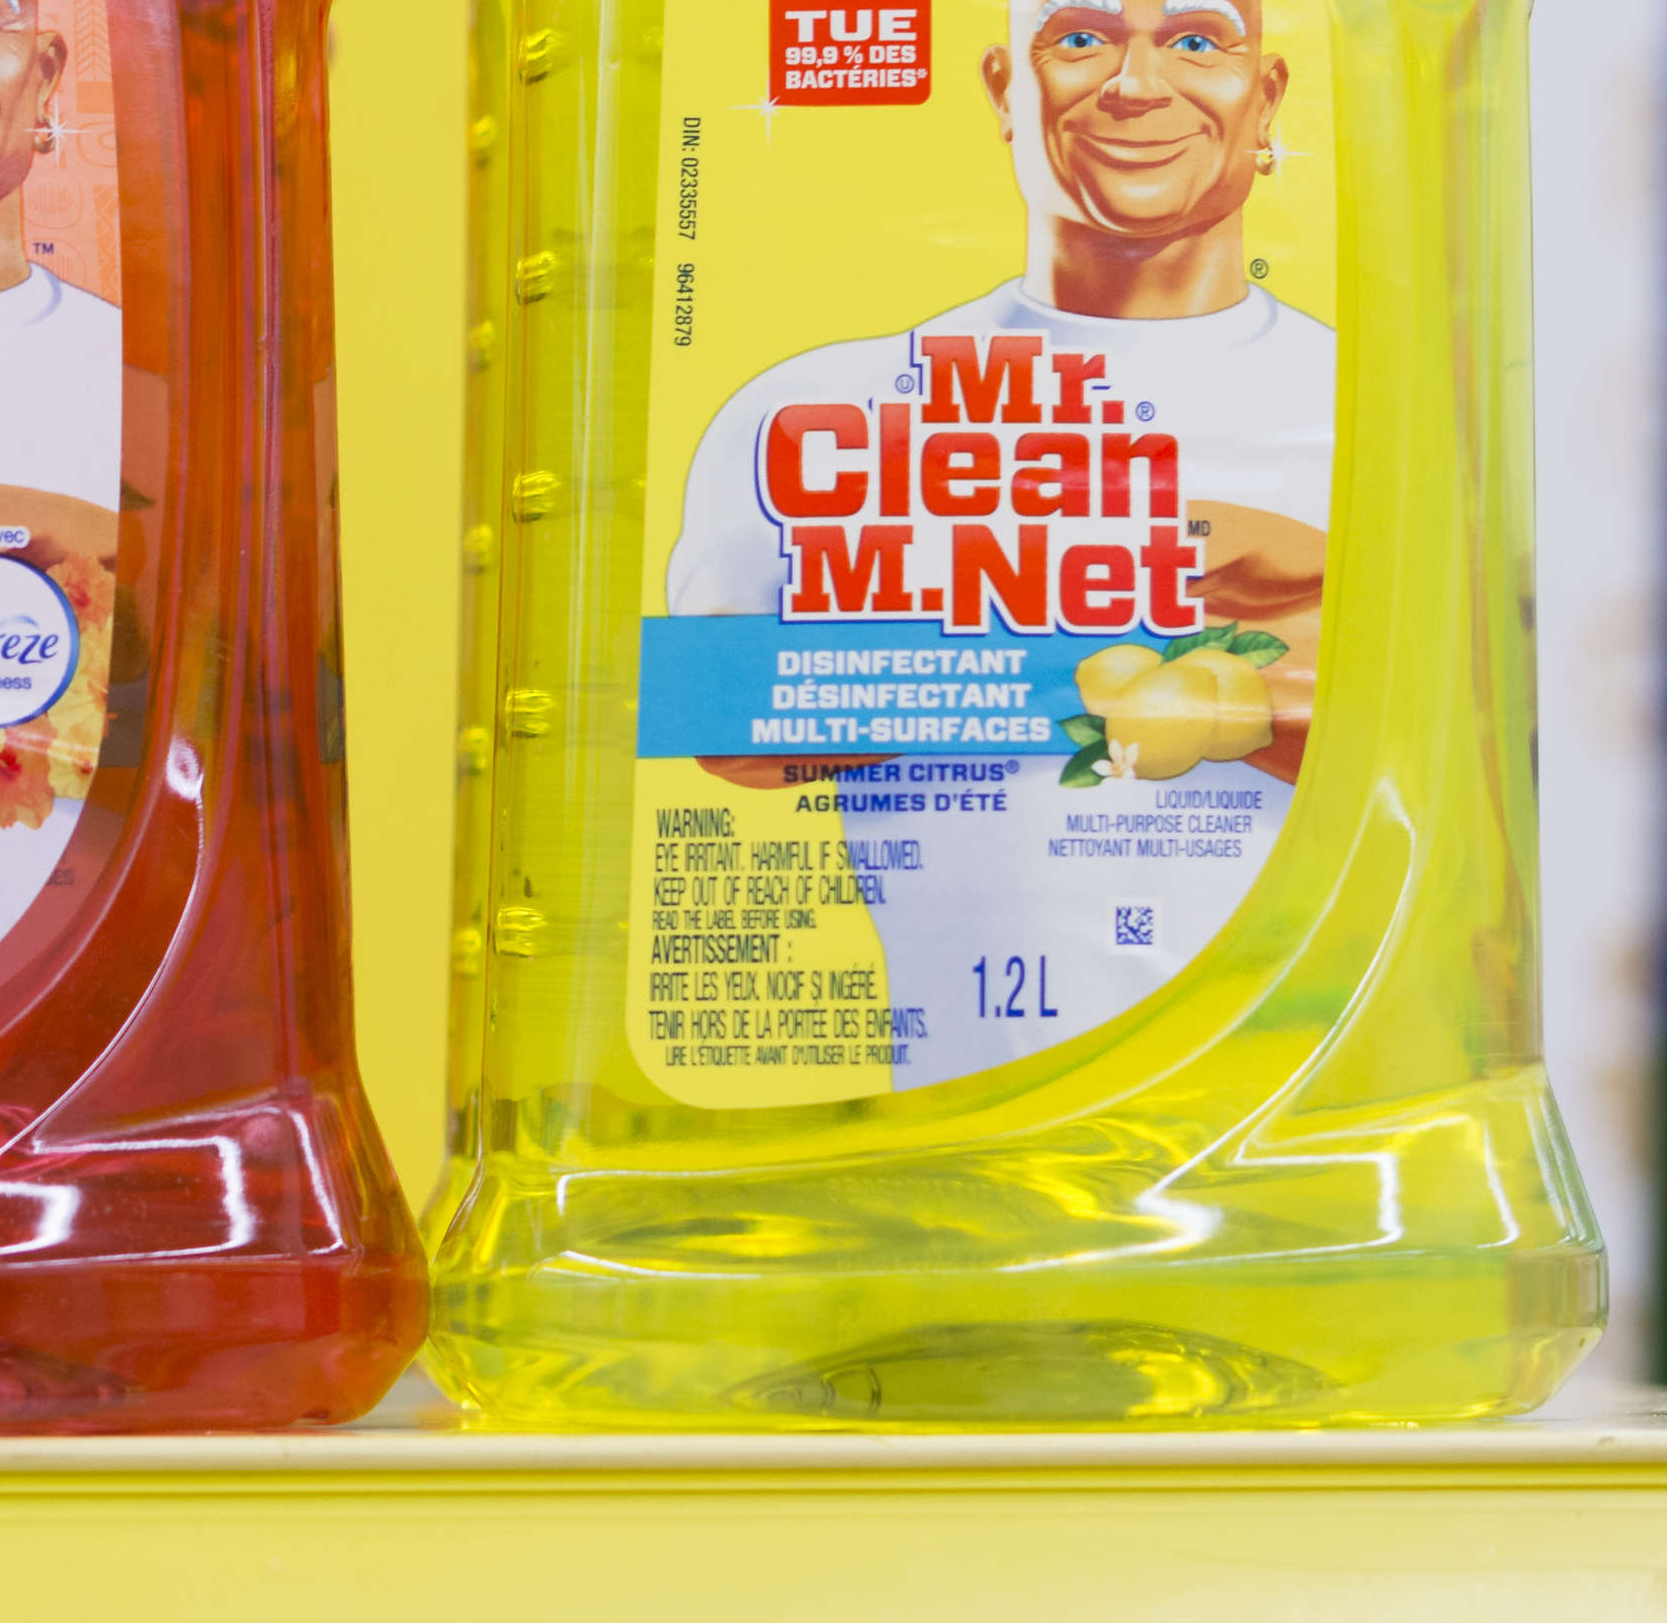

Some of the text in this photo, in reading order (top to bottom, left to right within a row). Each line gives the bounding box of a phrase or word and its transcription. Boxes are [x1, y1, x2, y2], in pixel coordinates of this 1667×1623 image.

[785, 9, 918, 42] TUE
[869, 45, 916, 63] DES
[675, 116, 701, 347] DIN: 02335557 96412879
[922, 334, 1124, 424] Mr.
[766, 401, 1180, 519] Clean
[778, 650, 1026, 676] DISINFECTANT
[772, 679, 1032, 709] DÉSINFECTANT
[752, 716, 1052, 743] MULTI-SURFACES
[783, 762, 901, 785] SUMMER
[796, 789, 1007, 814] AGRUMES D'ÉTÉ
[656, 809, 735, 838] WARNING:
[1067, 814, 1253, 834] MULTI-PURPOSE CLEANER
[1048, 839, 1243, 858] NETTOYANT MULTI-USAGES
[651, 934, 780, 964] AVERTISSEMENT
[972, 957, 1058, 1019] 1.2 L
